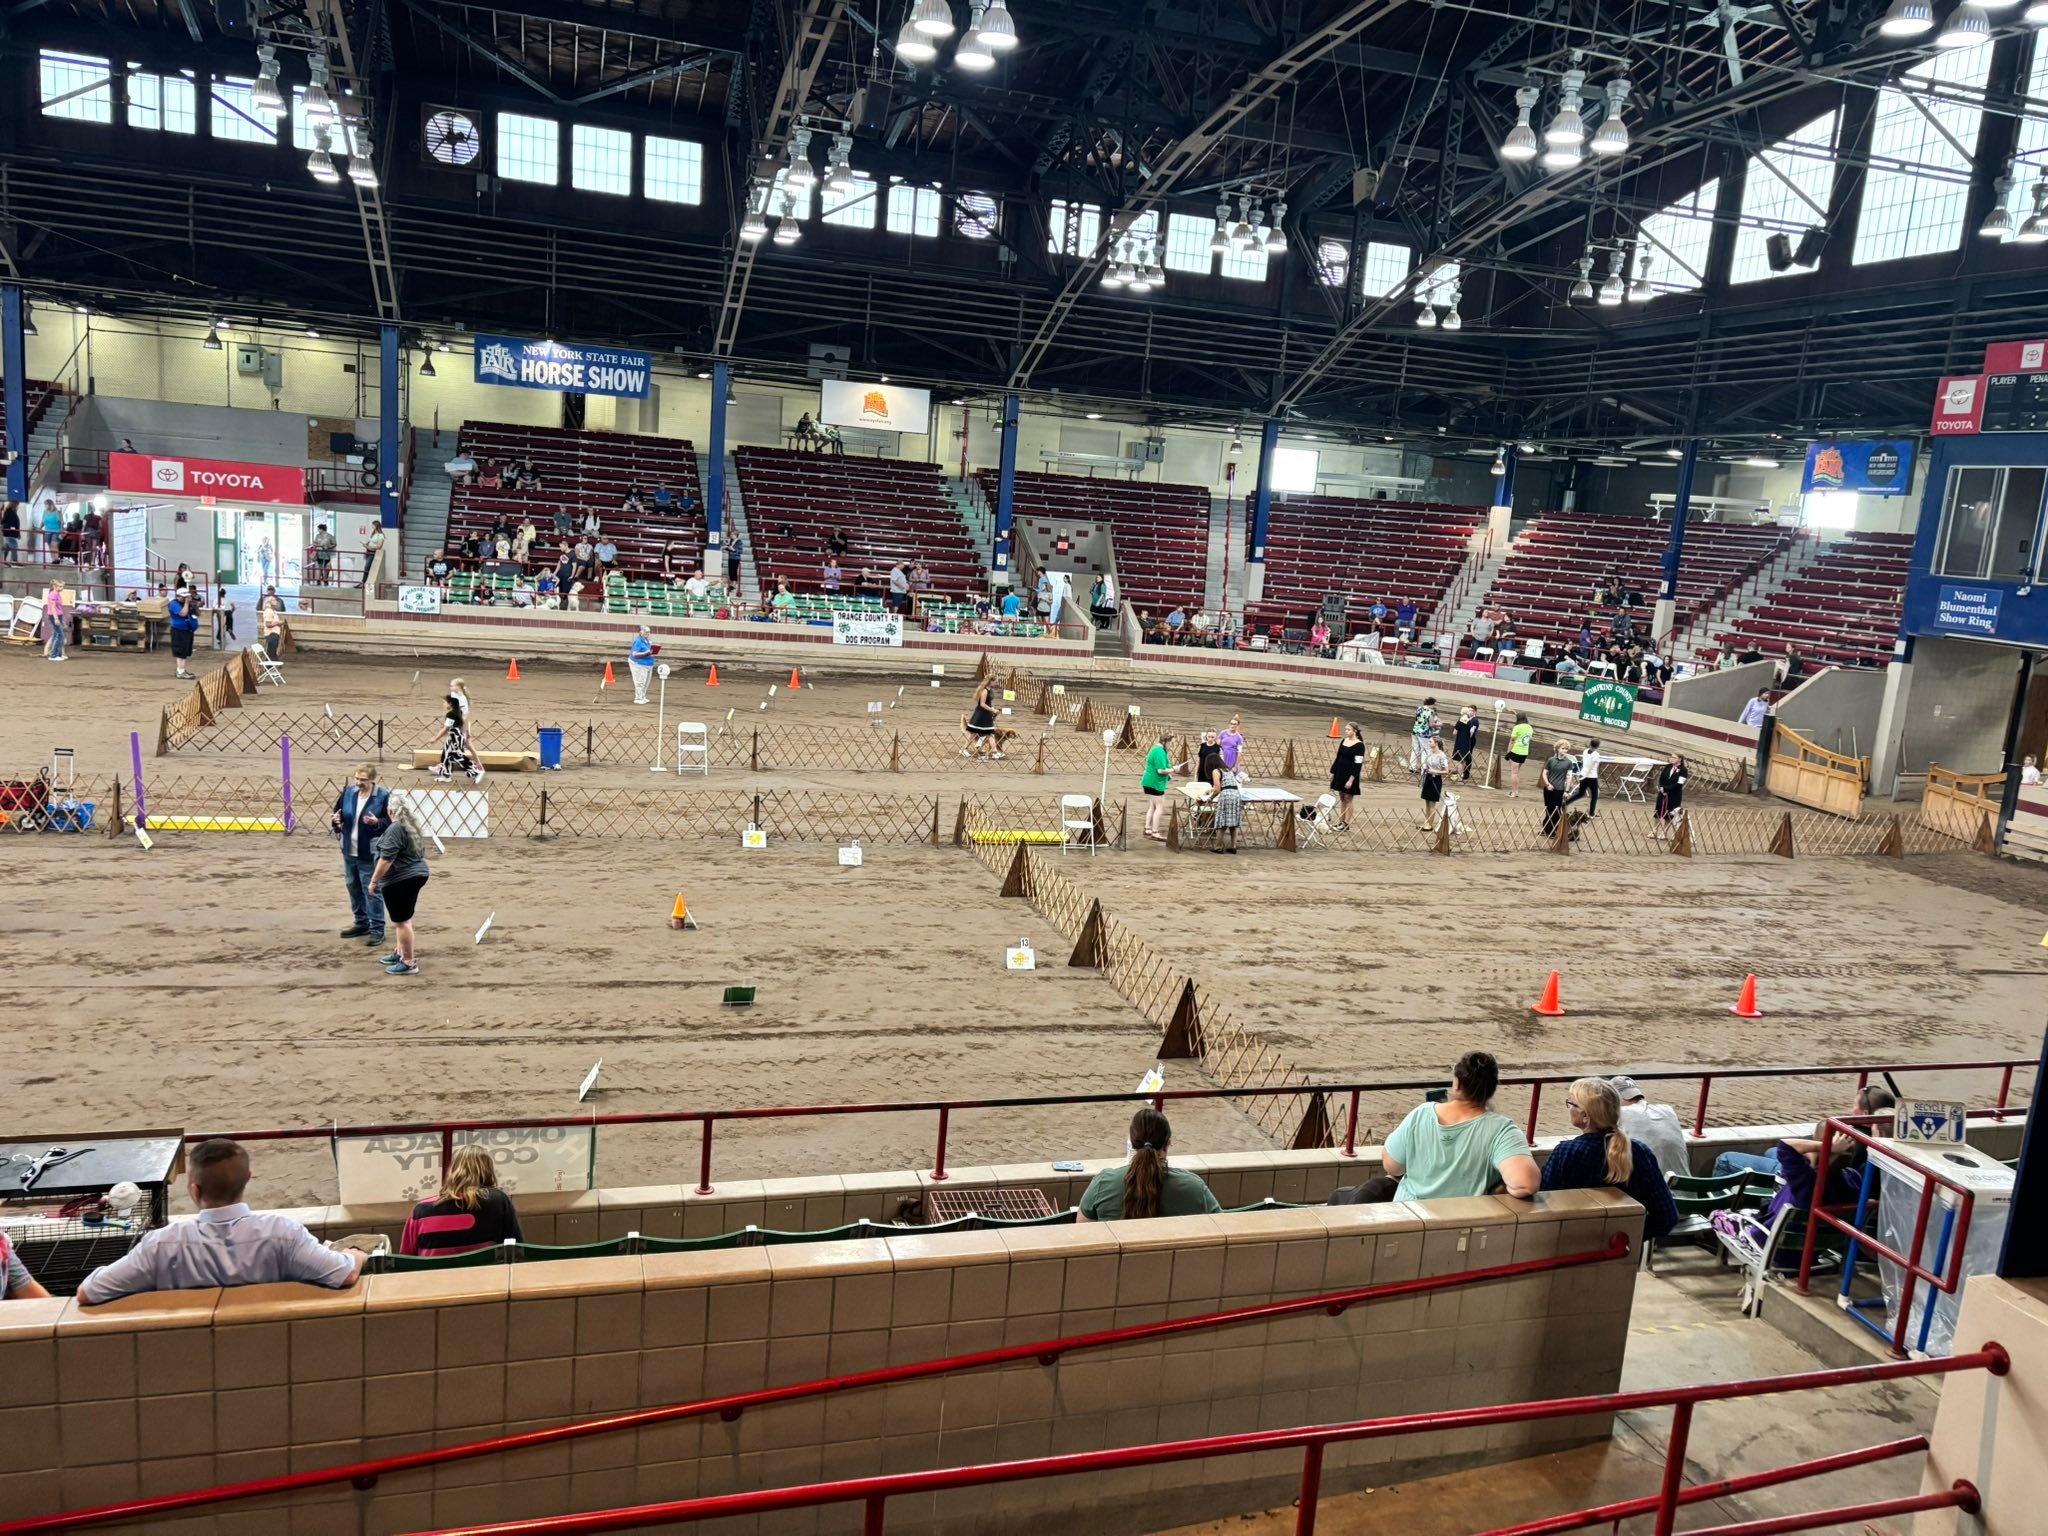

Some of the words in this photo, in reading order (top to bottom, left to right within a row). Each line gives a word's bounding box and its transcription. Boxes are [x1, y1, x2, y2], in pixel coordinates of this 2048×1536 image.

[486, 343, 510, 357] THE
[523, 345, 548, 357] NEW
[553, 349, 583, 360] YORK
[586, 353, 618, 364] STATE
[621, 355, 645, 367] FAIR
[480, 349, 517, 374] FAIR
[521, 359, 584, 387] HORSE
[588, 366, 645, 392] SHOW
[1991, 376, 2017, 385] PLAYER
[1936, 420, 1973, 430] TOYOTA
[190, 471, 264, 489] TOYOTA
[1953, 590, 1987, 603] Naomi
[1940, 601, 1997, 616] Blumenthal
[838, 612, 862, 621] ORANGE
[864, 613, 888, 622] COUNTY
[890, 615, 899, 623] 4H
[1939, 613, 1967, 624] Show
[1968, 615, 1992, 630] Ring
[845, 635, 858, 644] DOG
[860, 636, 890, 645] PROGRAM
[1585, 683, 1613, 697] TOMPKINS
[1615, 685, 1634, 703] COUNTY
[1022, 939, 1029, 947] 13
[1914, 1102, 1945, 1112] RECYCLE
